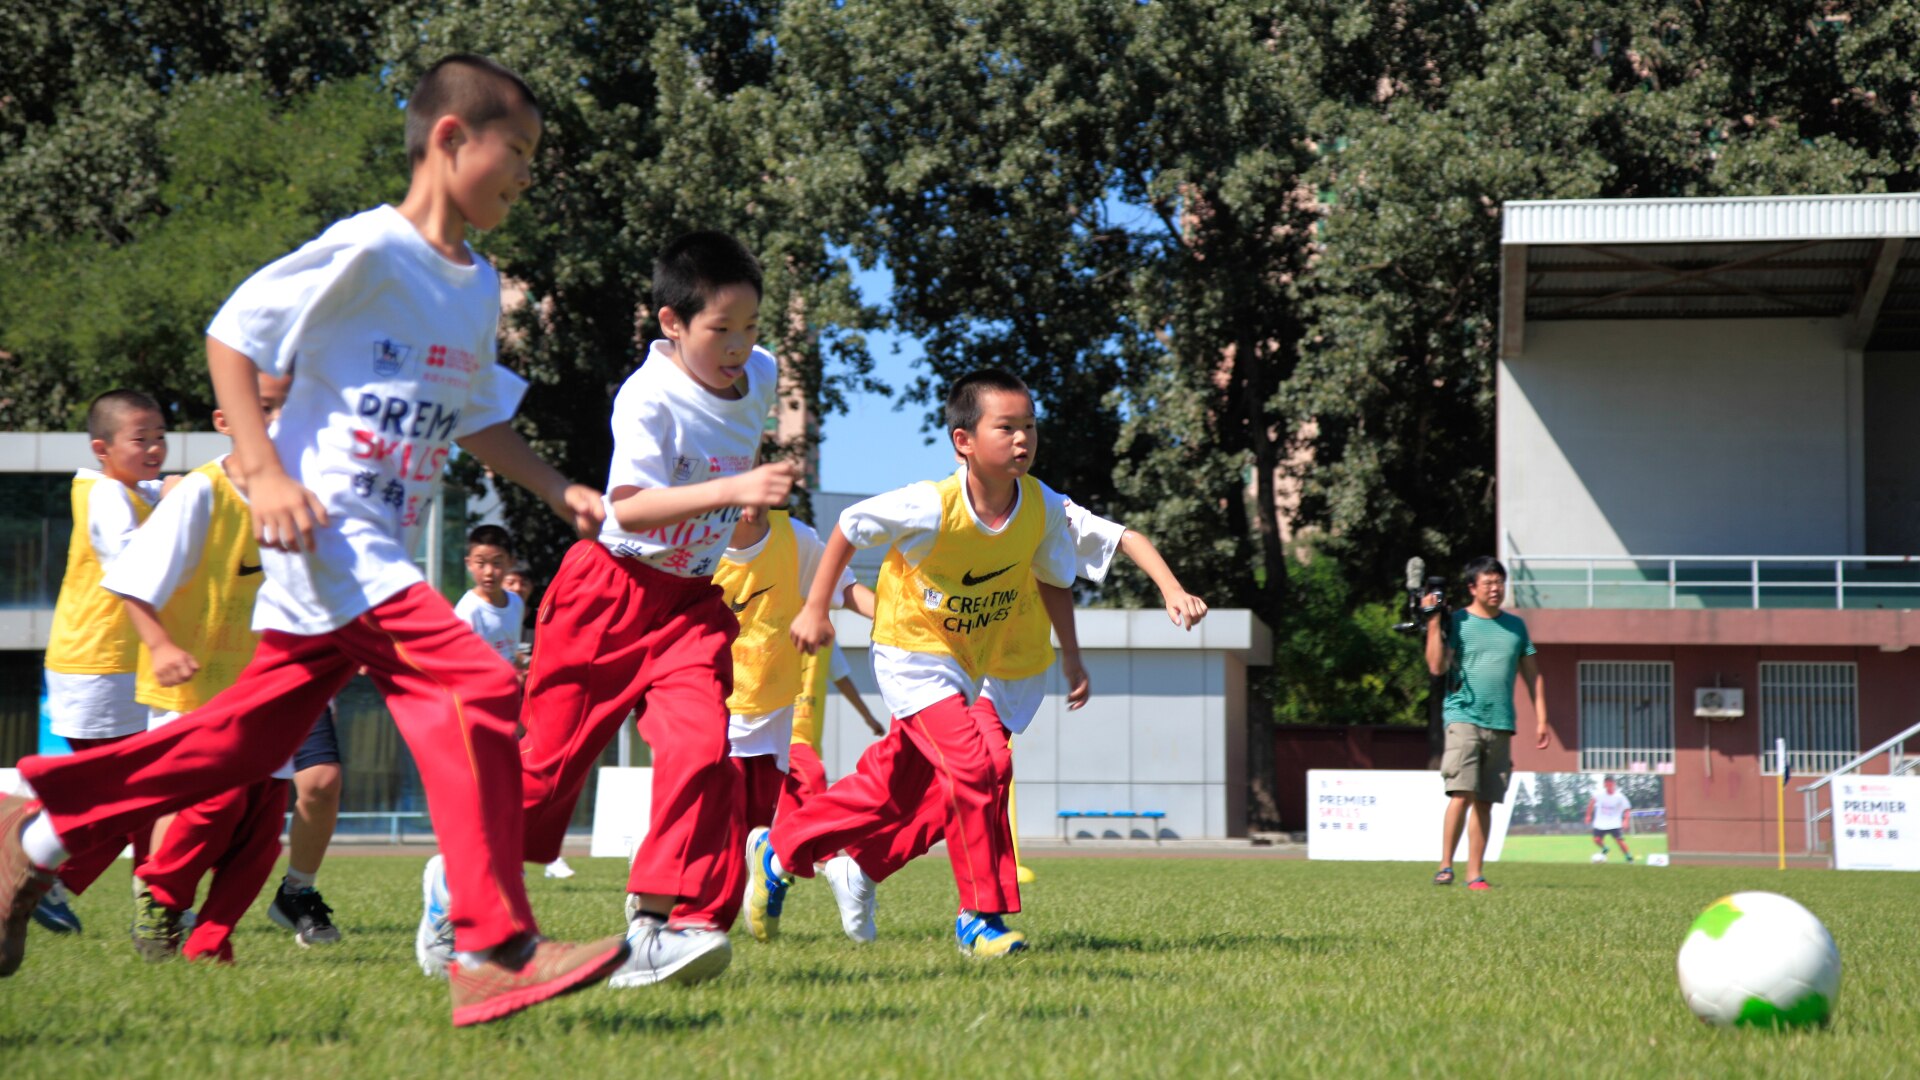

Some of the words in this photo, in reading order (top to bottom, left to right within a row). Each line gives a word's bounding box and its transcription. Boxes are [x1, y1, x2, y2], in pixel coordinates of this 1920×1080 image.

[1319, 795, 1377, 806] PREMIER
[1844, 800, 1906, 813] PREMIER
[1844, 814, 1889, 826] SKILLS
